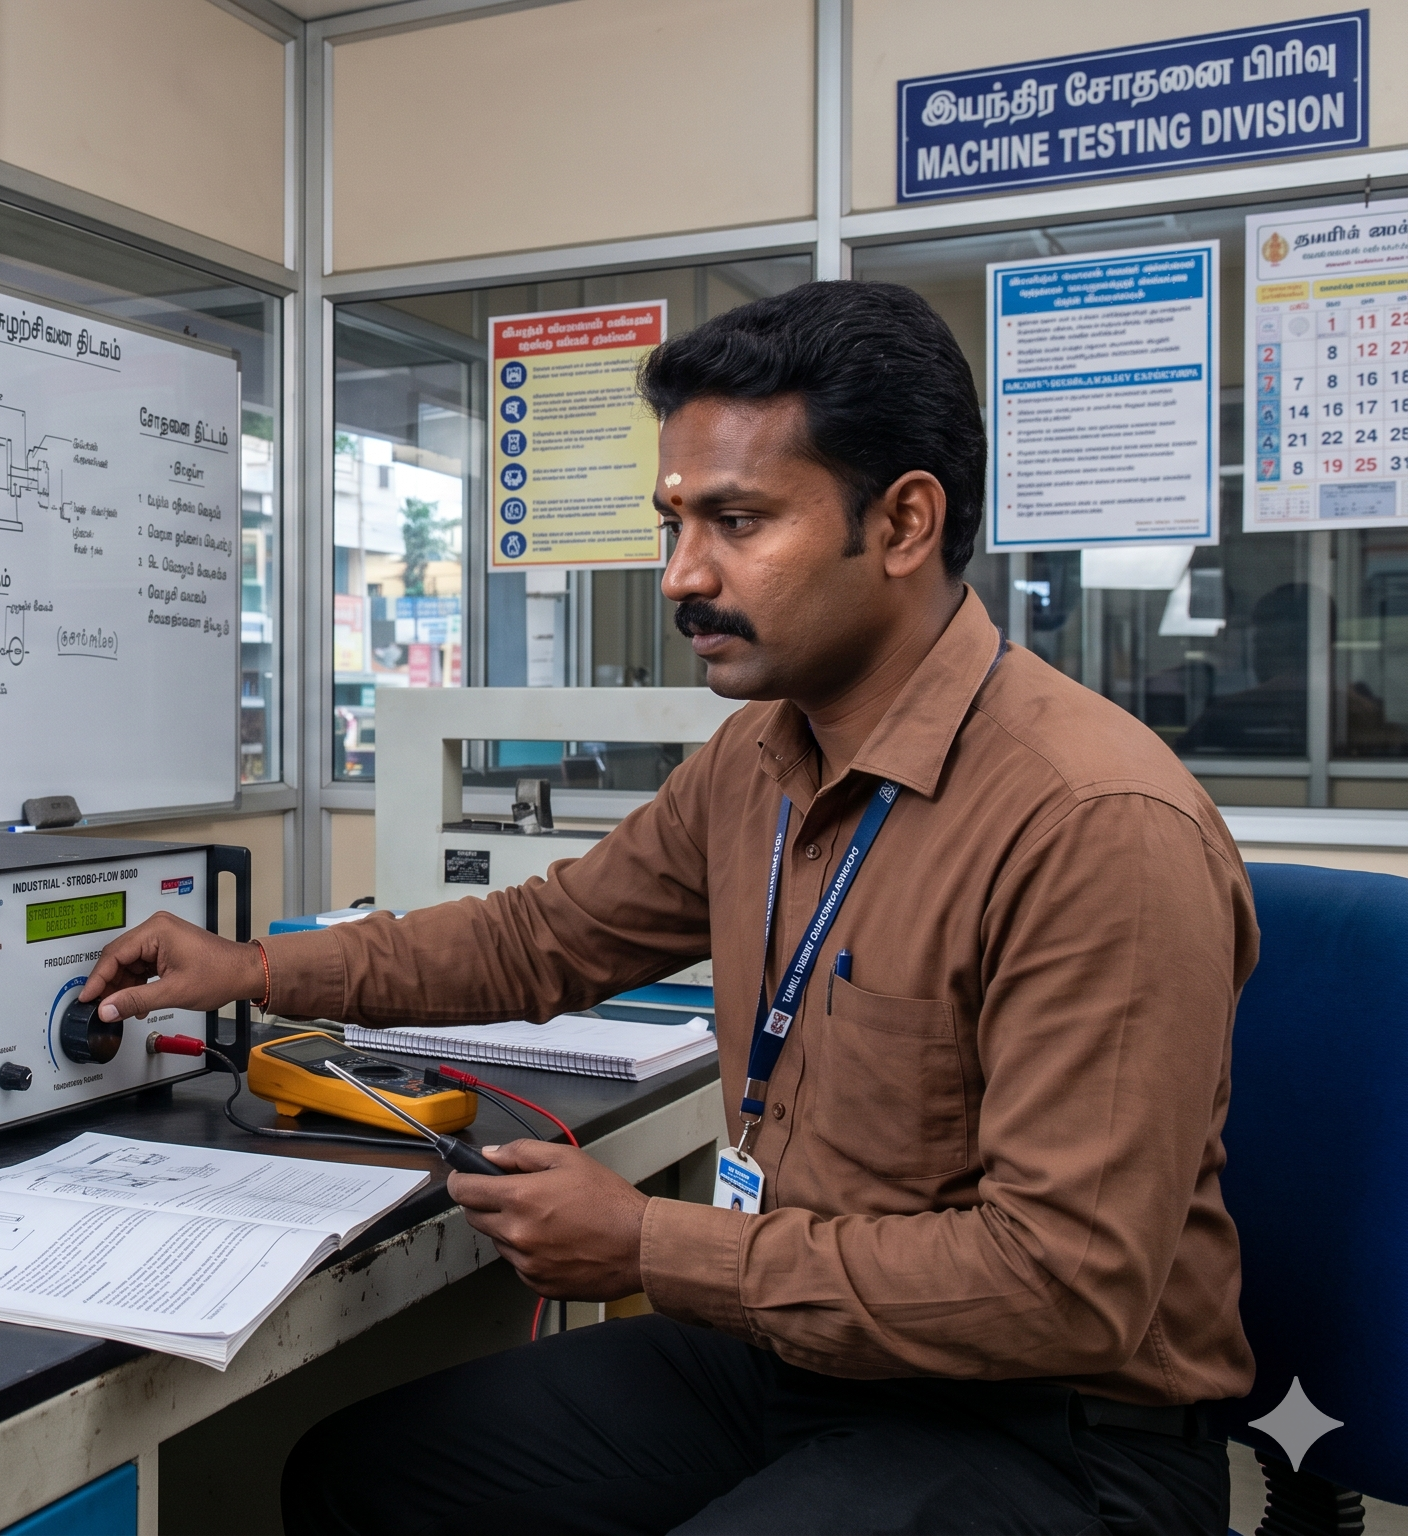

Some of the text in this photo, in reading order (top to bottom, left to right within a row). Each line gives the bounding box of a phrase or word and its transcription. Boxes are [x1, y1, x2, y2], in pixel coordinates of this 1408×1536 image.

[921, 38, 1337, 128] இயந்திர சோதனை பிரிவு
[917, 92, 1345, 181] MACHINE TESTING DIVISION
[1327, 317, 1336, 332] 1
[1357, 314, 1376, 330] 11
[1263, 347, 1274, 362] 2
[1327, 345, 1337, 360] 8
[1357, 342, 1378, 357] 12
[1293, 376, 1304, 391] 7
[1327, 374, 1338, 389] 8
[1357, 372, 1378, 387] 16
[1289, 404, 1309, 419] 14
[1323, 402, 1343, 417] 16
[1356, 400, 1378, 415] 17
[1287, 433, 1307, 448] 21
[1321, 431, 1343, 445] 22
[1355, 429, 1378, 443] 24
[1293, 461, 1304, 475] 8
[1323, 459, 1343, 473] 19
[1355, 457, 1377, 472] 25
[12, 878, 61, 894] INDUSTRIAL
[66, 871, 119, 887] STROBO-FLOW
[120, 868, 139, 880] 8000
